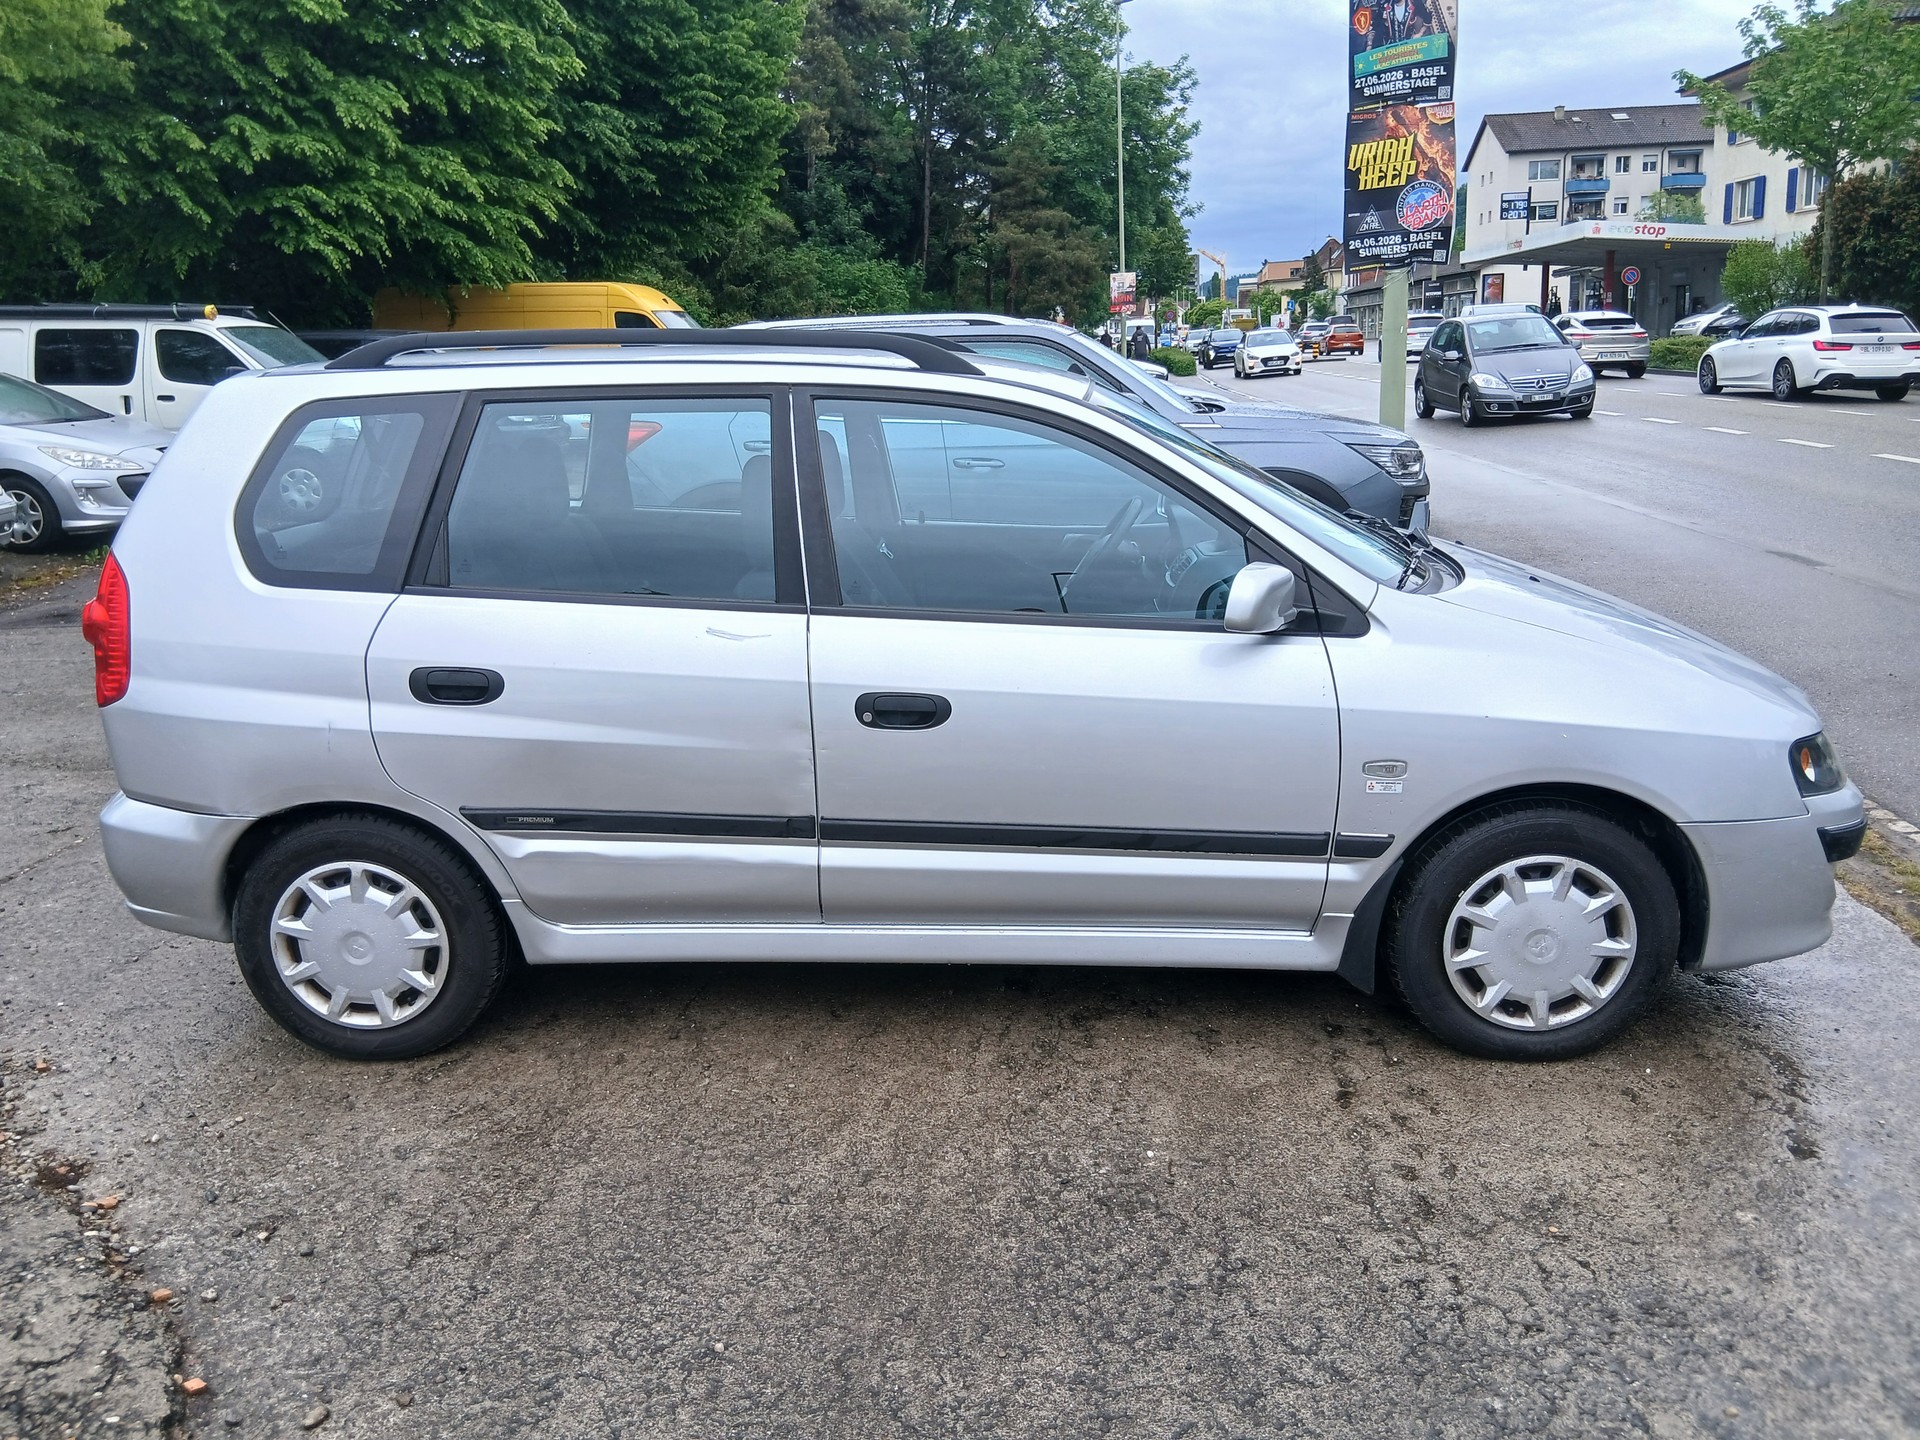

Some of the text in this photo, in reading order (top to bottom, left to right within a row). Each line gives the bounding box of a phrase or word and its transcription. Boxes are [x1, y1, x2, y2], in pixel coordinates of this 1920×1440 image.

[1383, 41, 1428, 57] TOURISTES
[1354, 66, 1447, 89] 27.06.2026 BASEL
[1363, 77, 1437, 97] SUMMERSTAGE
[1347, 131, 1417, 172] URIAH
[1358, 160, 1417, 191] HEEP
[1412, 203, 1450, 230] BAND
[1349, 231, 1444, 250] 26.06.2026 BASEL
[1359, 241, 1433, 257] SUMMERSTAGE
